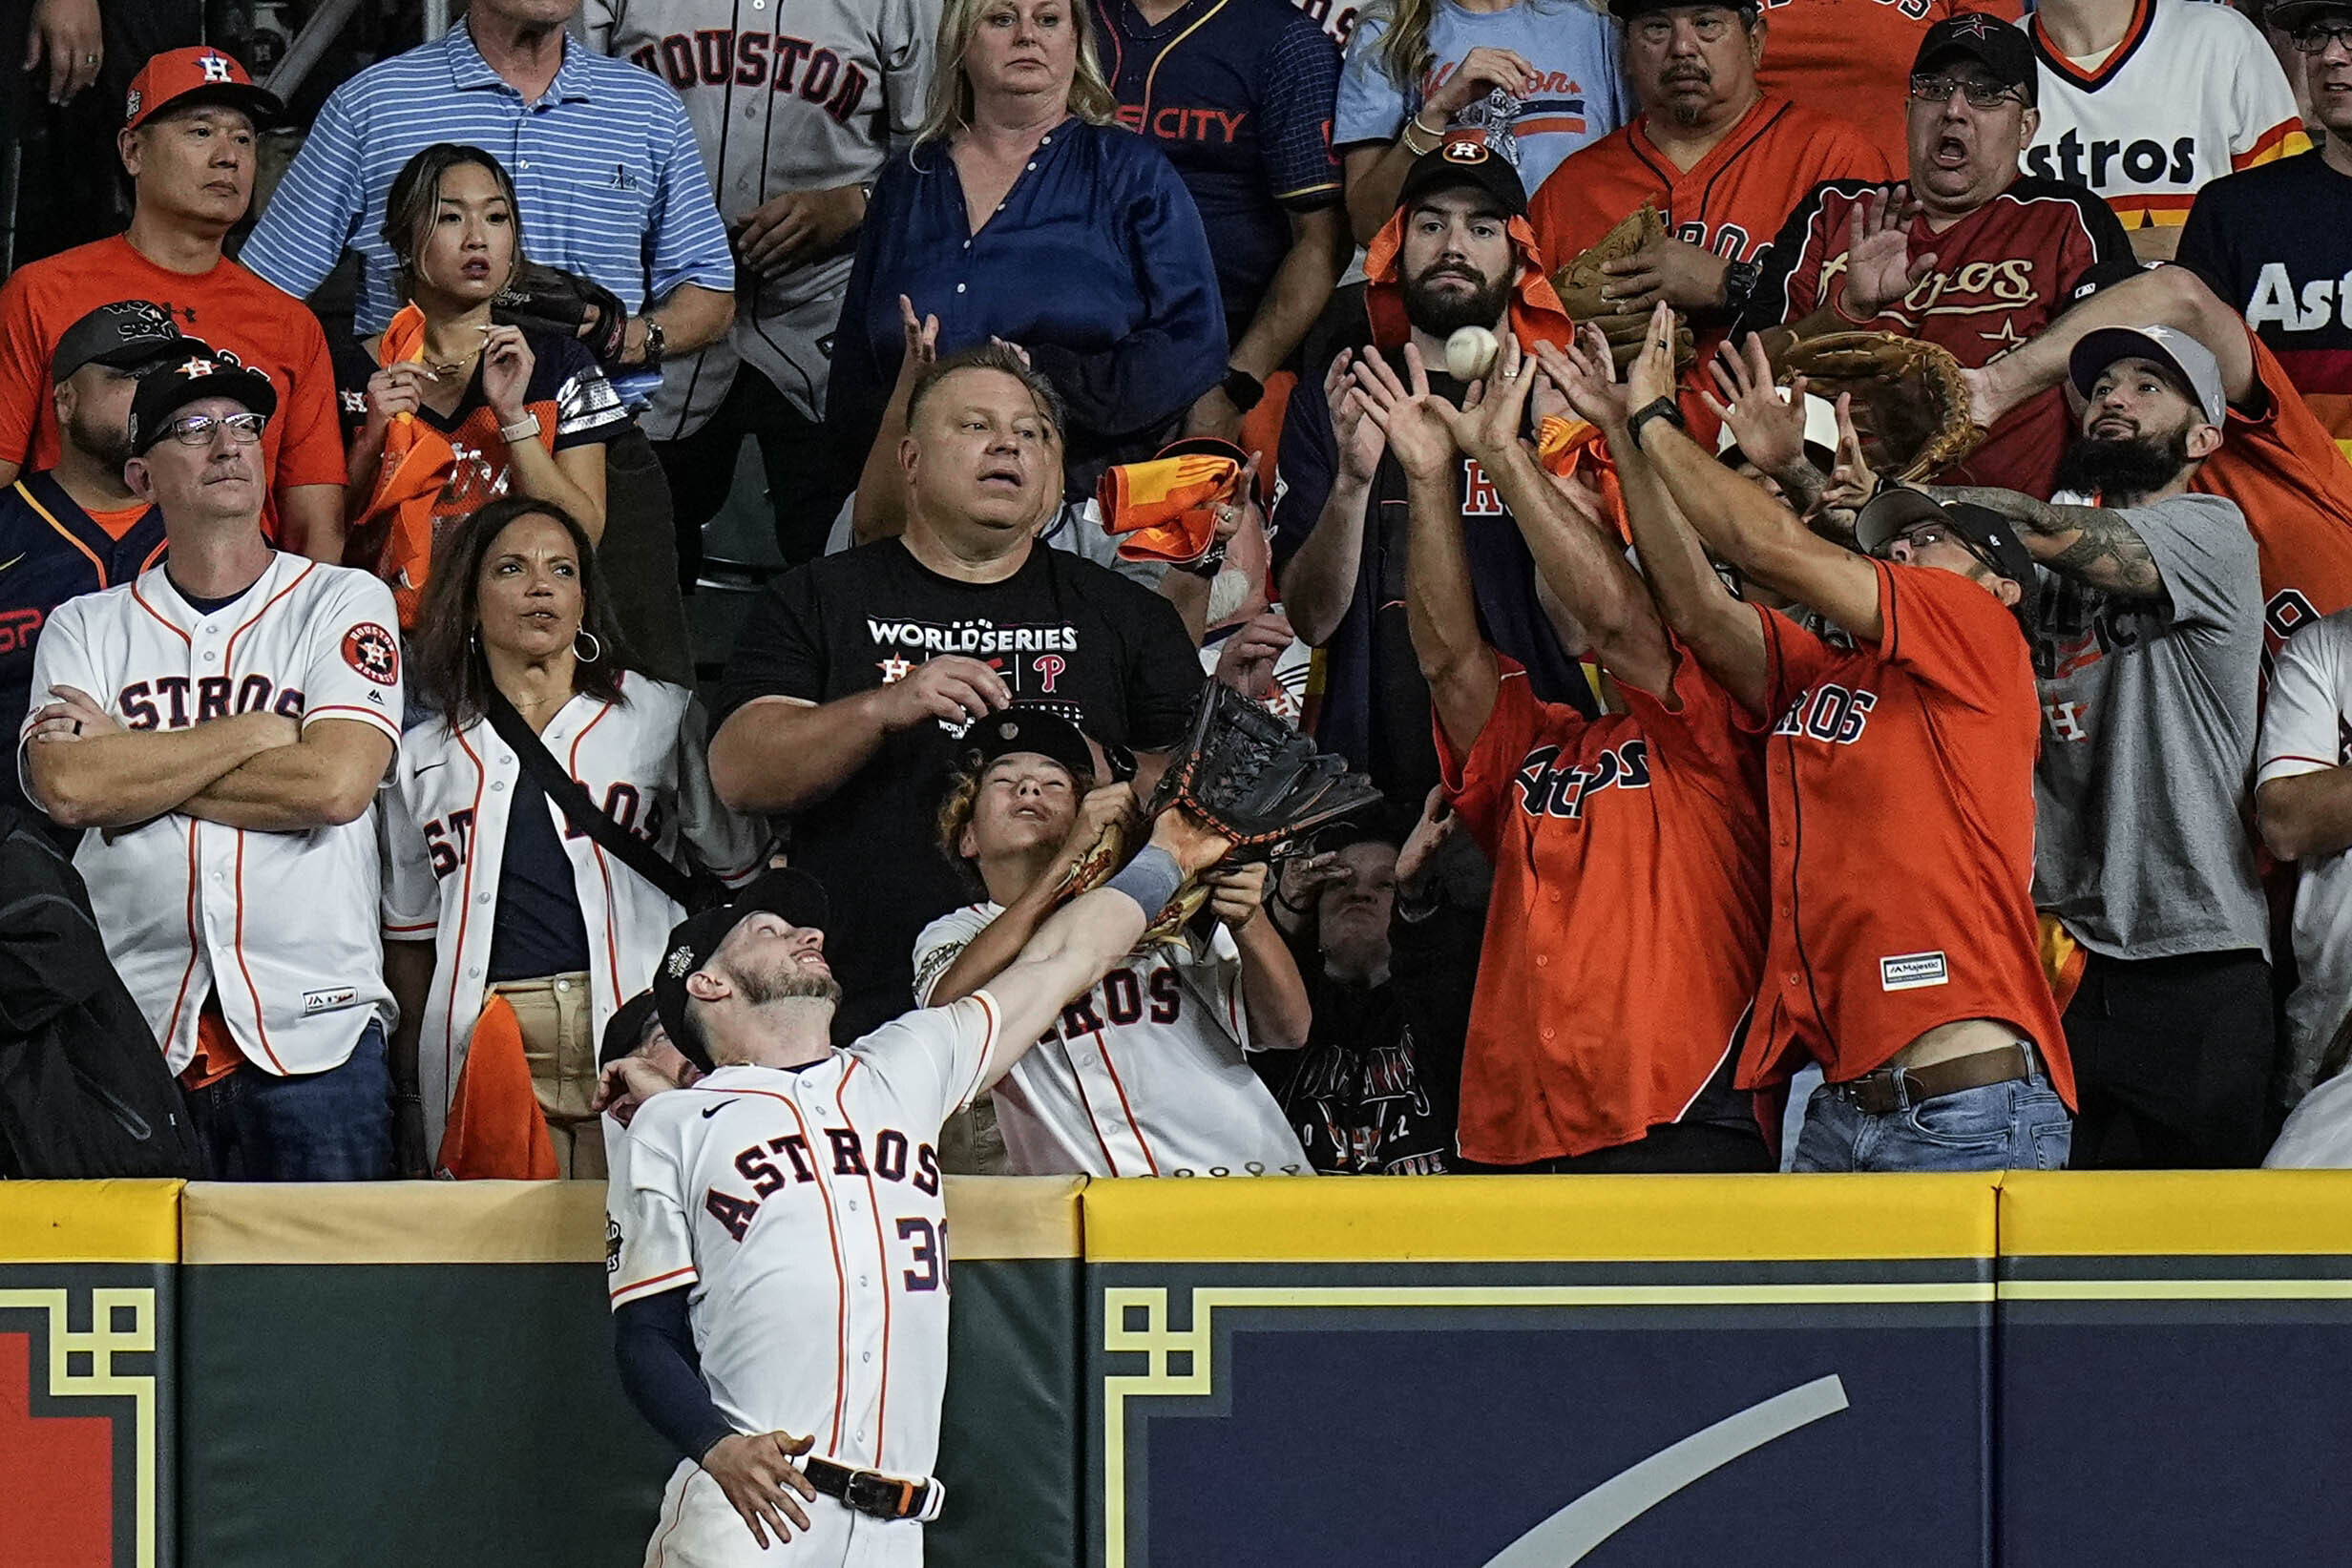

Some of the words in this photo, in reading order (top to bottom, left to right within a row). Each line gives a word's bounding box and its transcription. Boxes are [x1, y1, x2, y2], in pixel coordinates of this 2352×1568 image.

[200, 56, 232, 83] H
[1153, 107, 1247, 143] CITY
[1452, 142, 1479, 157] H
[2026, 127, 2194, 189] stros
[183, 359, 214, 380] H
[1033, 655, 1066, 693] P
[1774, 682, 1879, 744] ROS
[2045, 700, 2088, 742] H
[1039, 967, 1181, 1045] ROS
[704, 1127, 941, 1244] ASTROS
